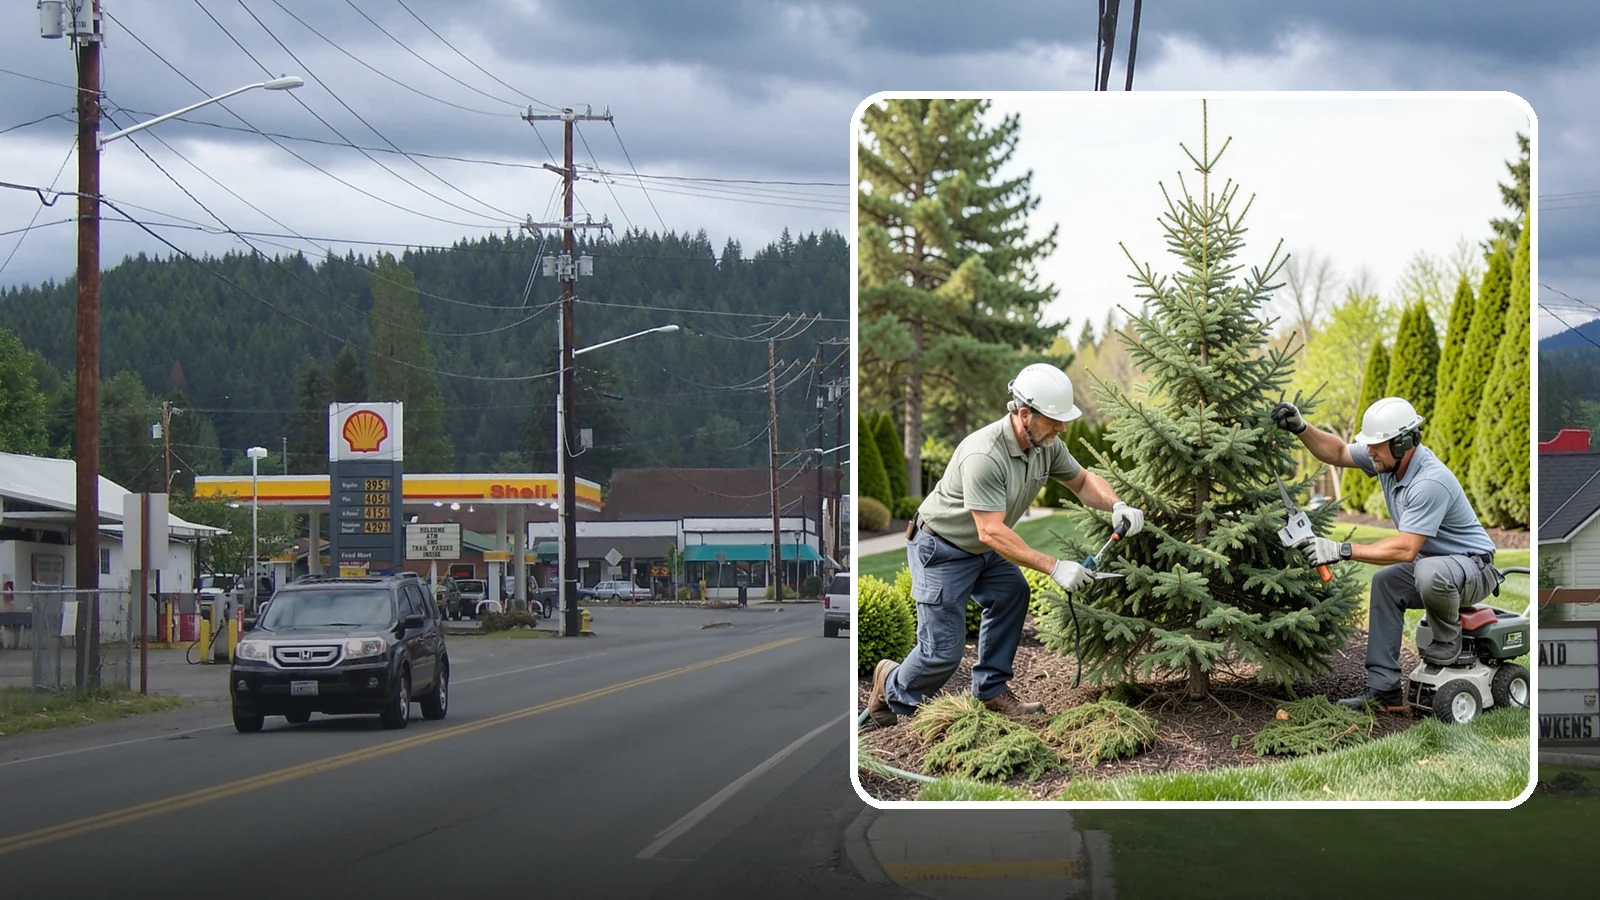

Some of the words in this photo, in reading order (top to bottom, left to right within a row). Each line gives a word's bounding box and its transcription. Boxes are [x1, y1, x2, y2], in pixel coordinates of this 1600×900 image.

[366, 480, 383, 490] 395
[490, 484, 547, 499] Shell
[366, 494, 383, 504] 405
[366, 508, 383, 518] 415
[366, 523, 383, 533] 429
[1539, 643, 1566, 665] AID
[1538, 715, 1592, 738] WKENS
